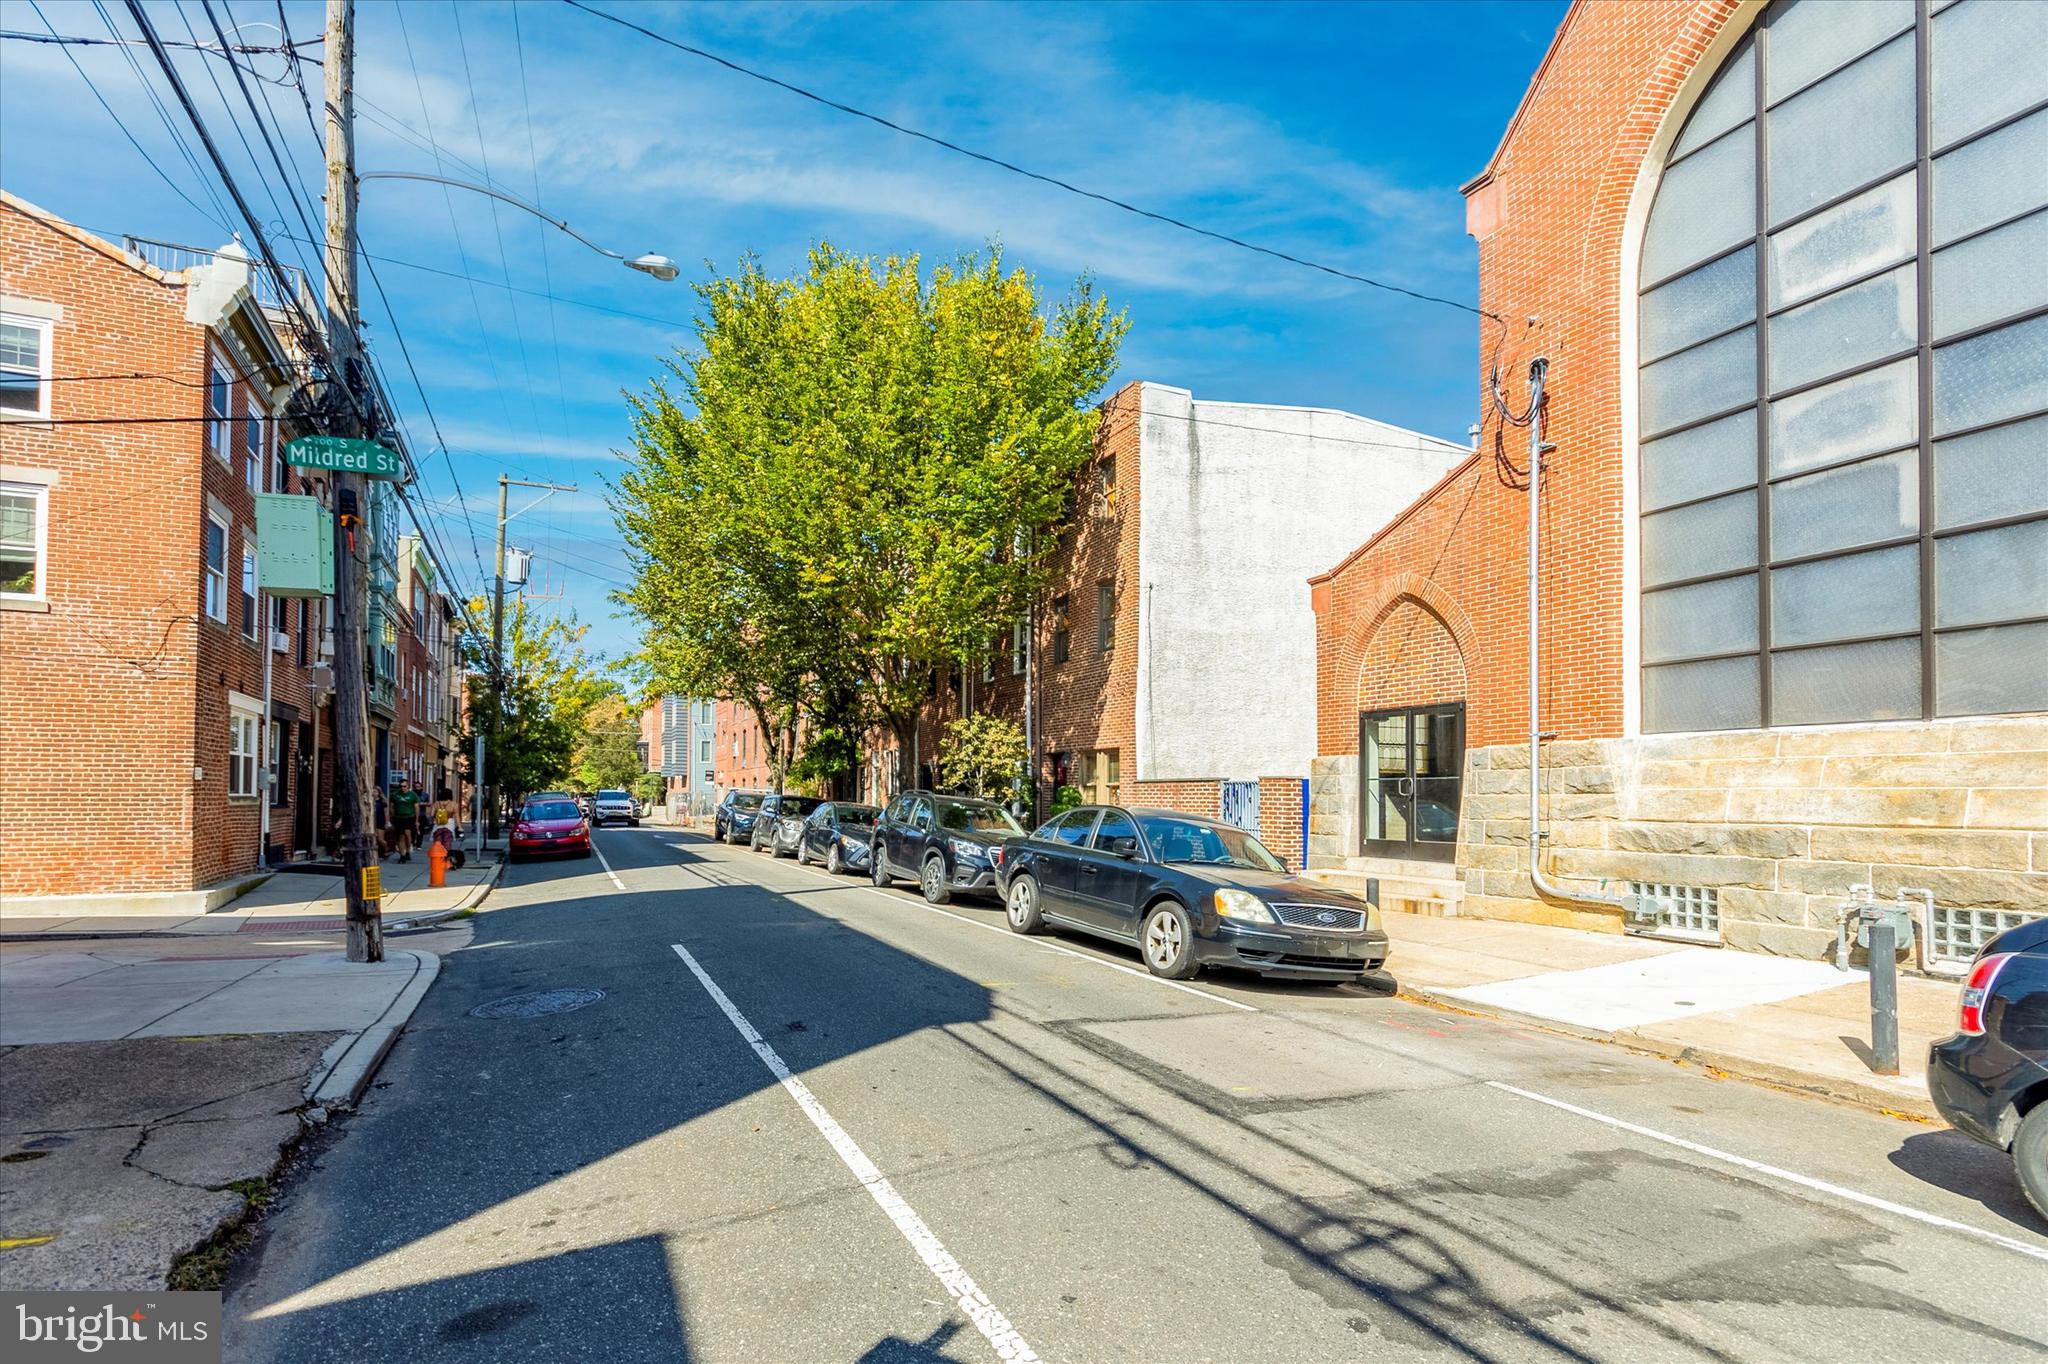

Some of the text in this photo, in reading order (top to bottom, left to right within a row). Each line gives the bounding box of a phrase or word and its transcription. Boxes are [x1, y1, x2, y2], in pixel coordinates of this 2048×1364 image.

[340, 438, 348, 448] S
[290, 444, 395, 472] Mildred St
